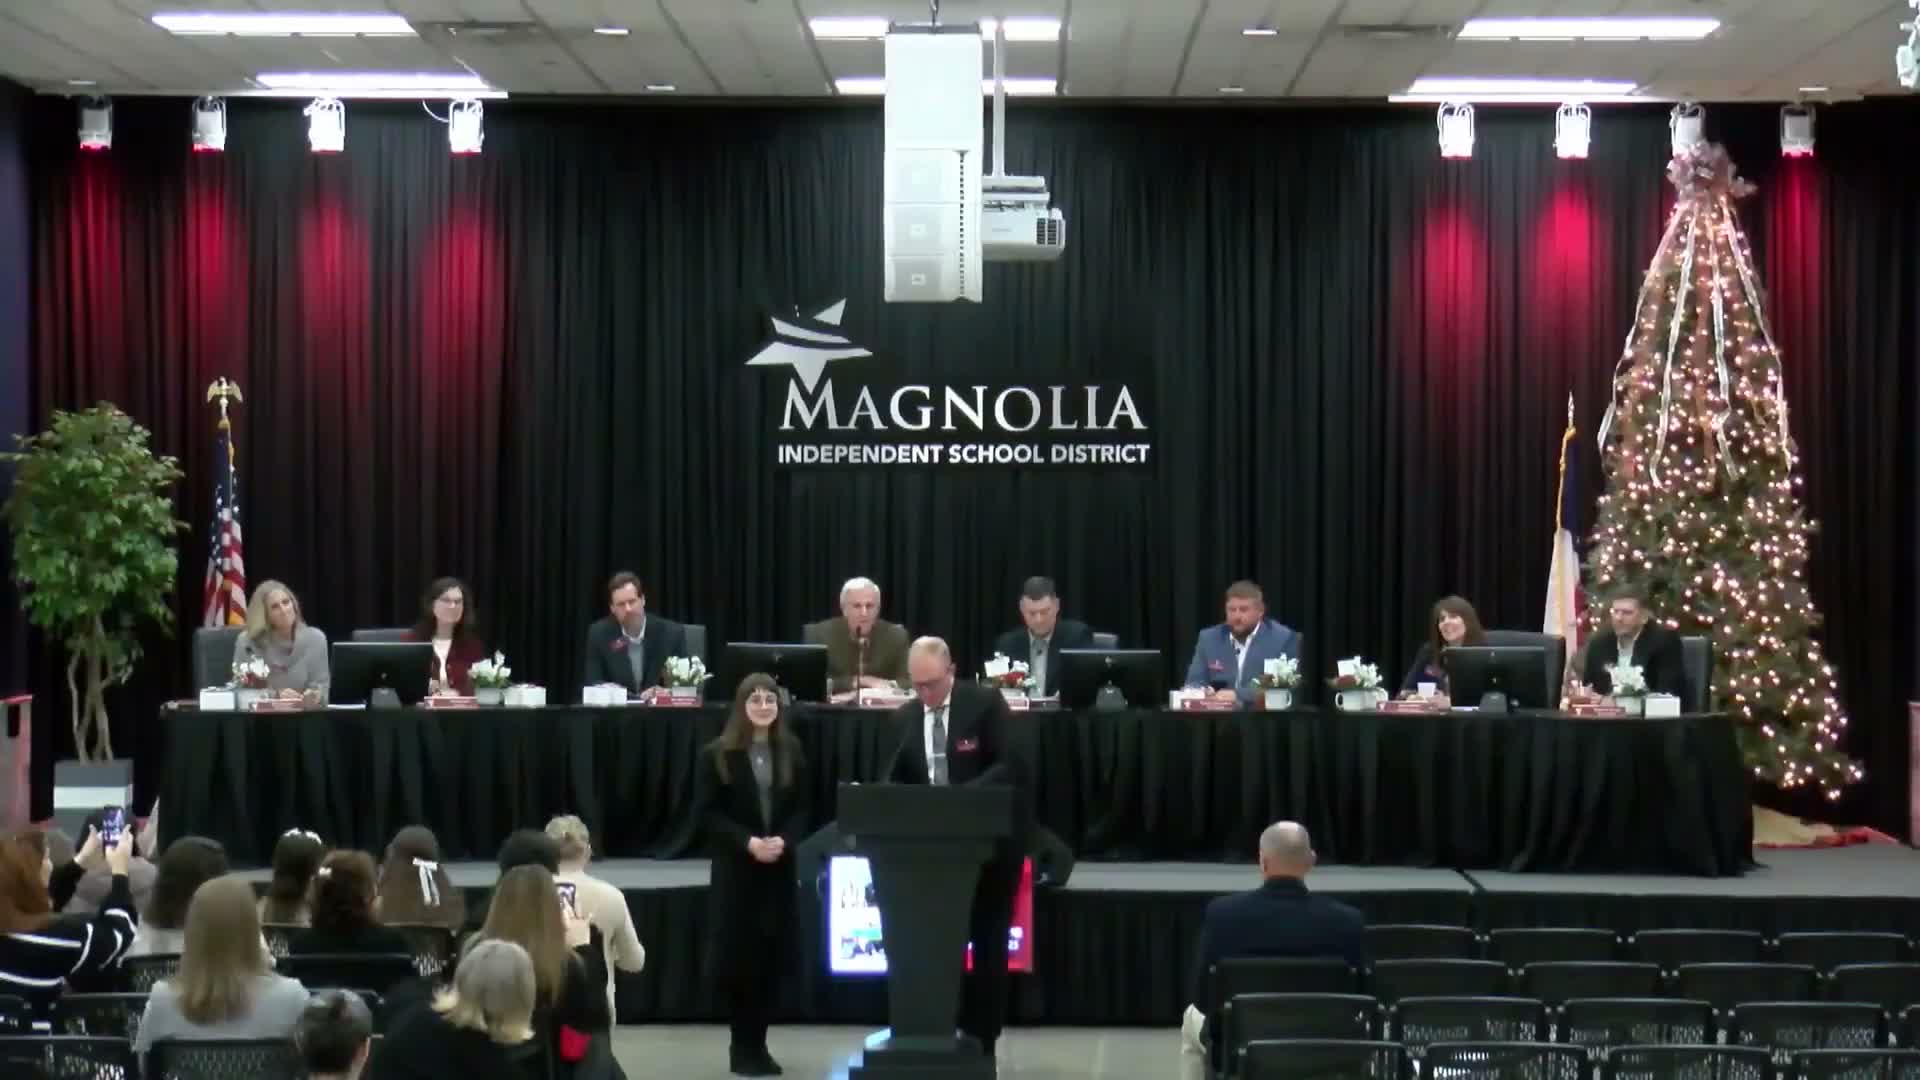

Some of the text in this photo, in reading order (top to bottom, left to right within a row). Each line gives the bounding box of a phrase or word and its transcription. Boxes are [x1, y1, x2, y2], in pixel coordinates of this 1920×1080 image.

[779, 377, 1148, 432] MAGNOLIA
[778, 443, 1150, 463] INDEPENDENT SCHOOL DISTRICT
